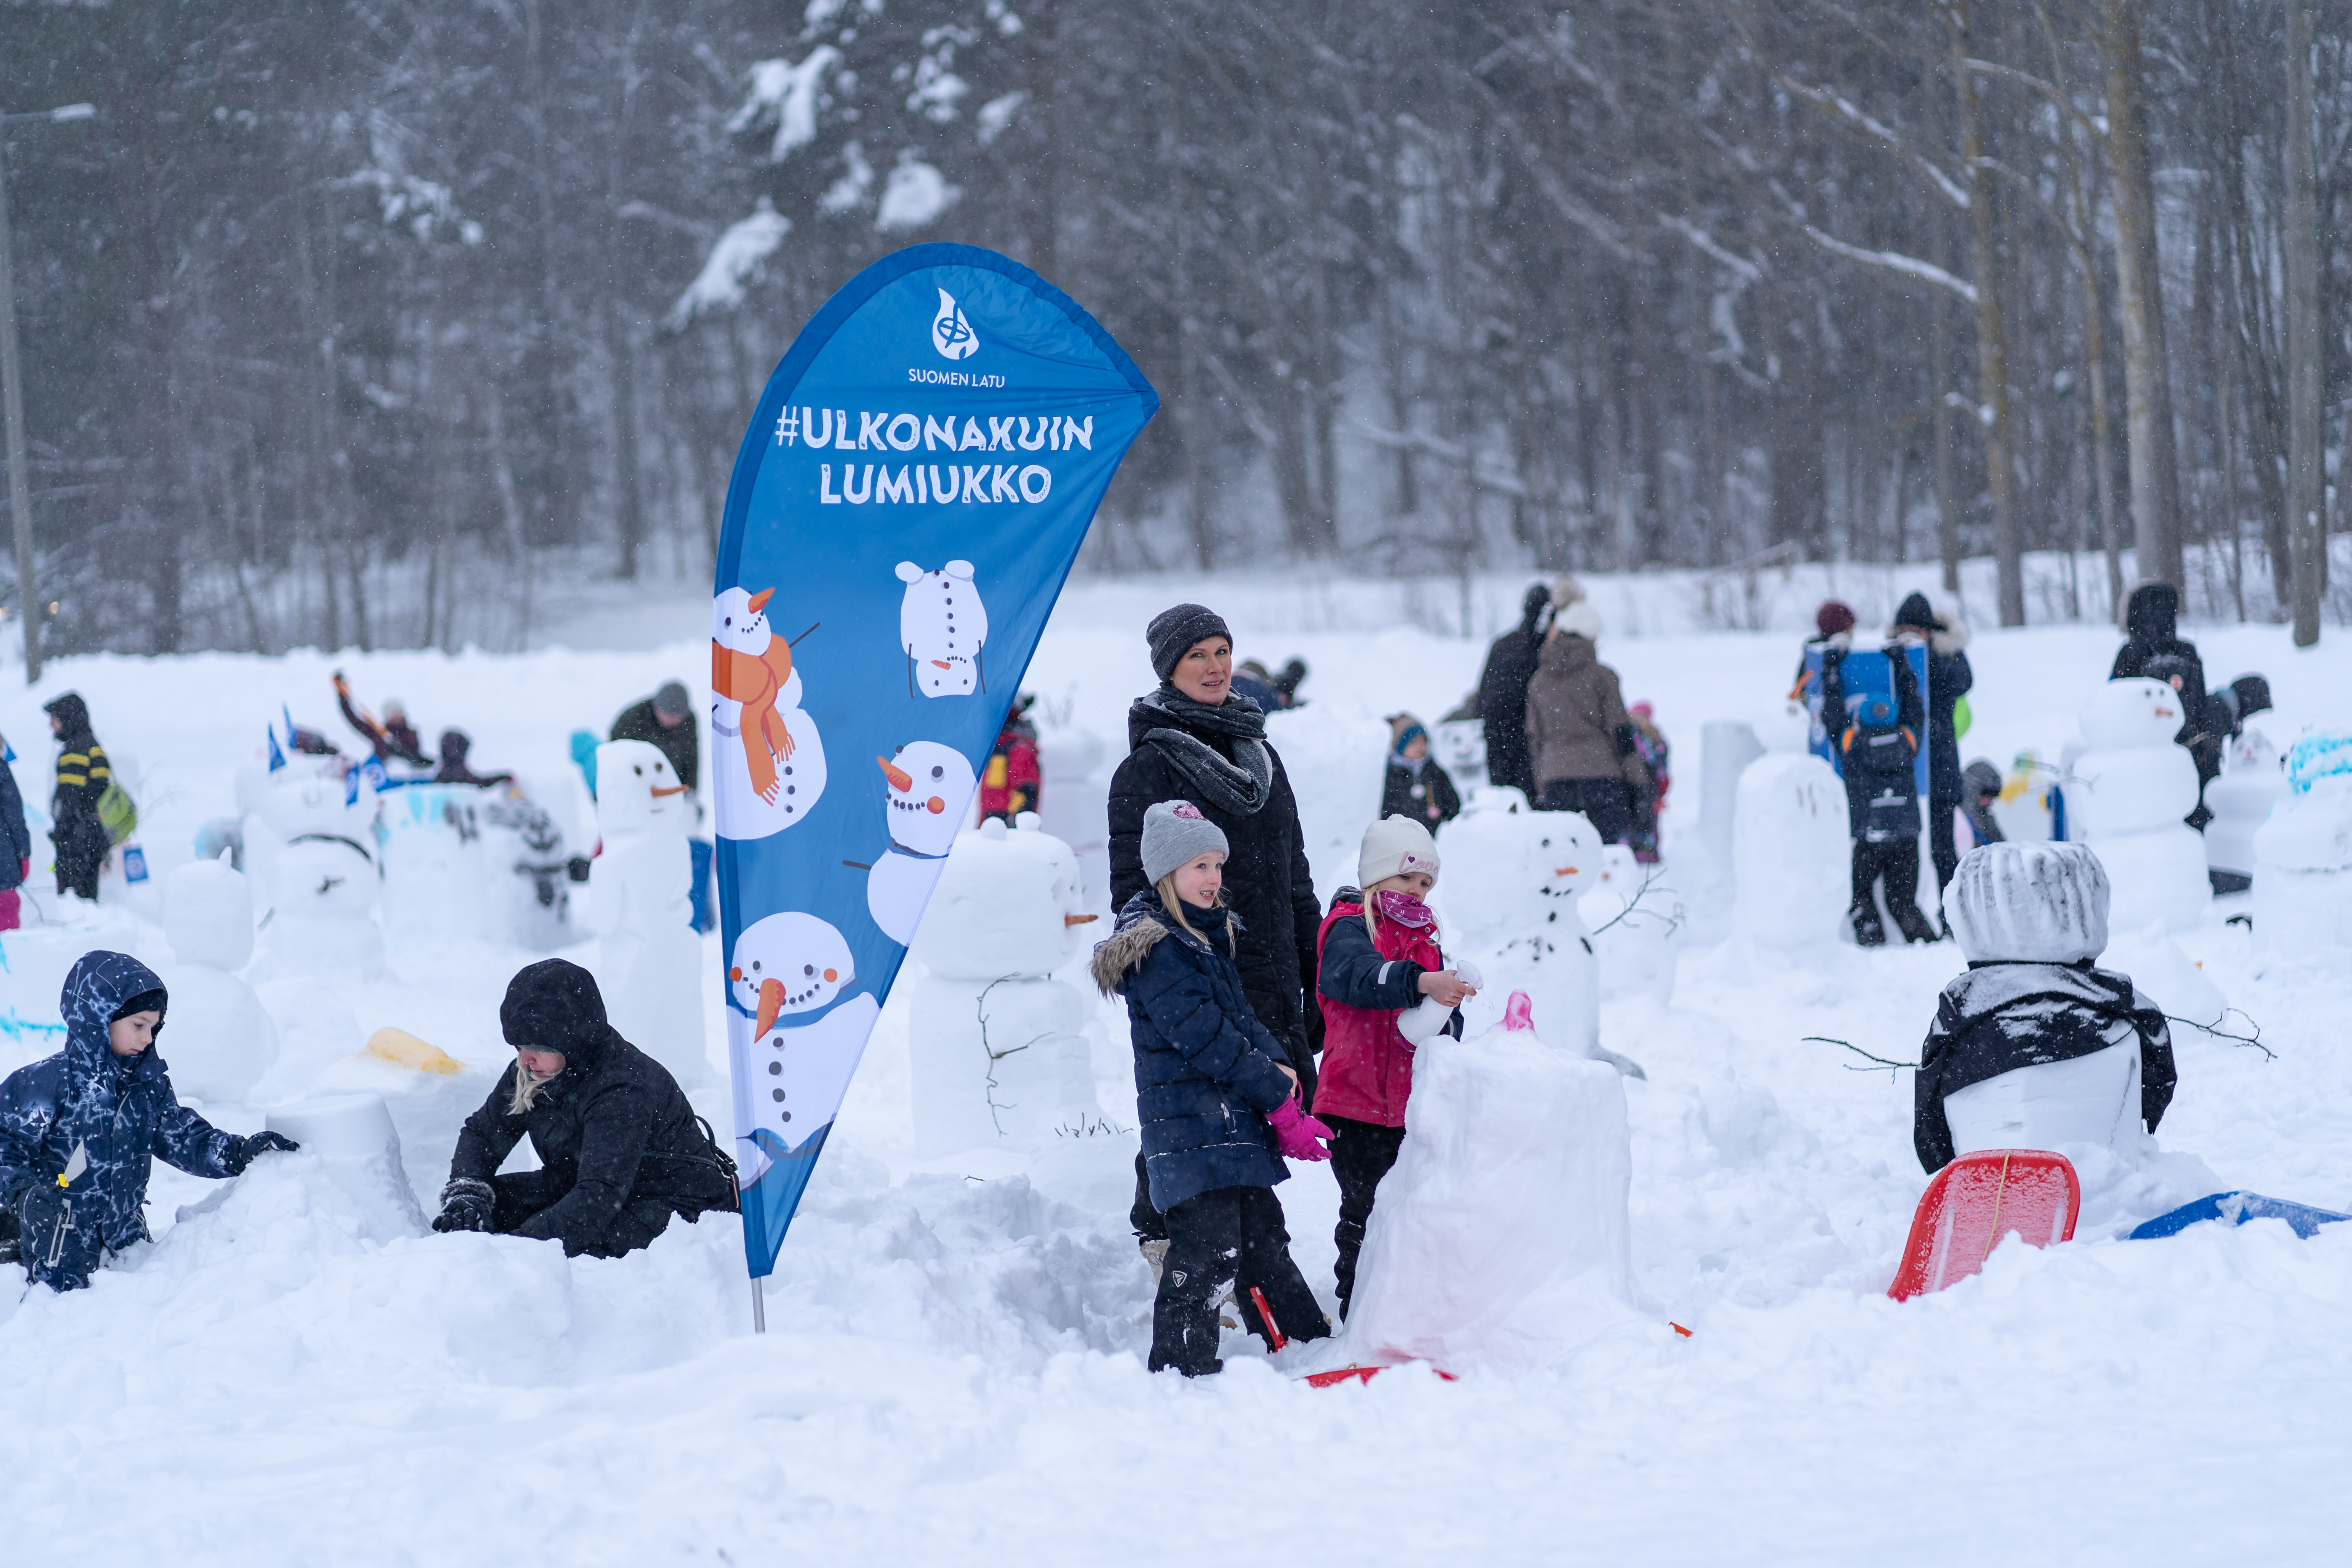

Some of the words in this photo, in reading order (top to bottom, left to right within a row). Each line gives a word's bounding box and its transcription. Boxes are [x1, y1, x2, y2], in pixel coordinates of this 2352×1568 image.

[909, 368, 968, 386] SUOMEN
[972, 374, 1005, 388] LATU
[775, 405, 1093, 451] #ULKONAKUIN
[821, 464, 1051, 504] LUMIUKKO
[1398, 851, 1439, 874] Love
